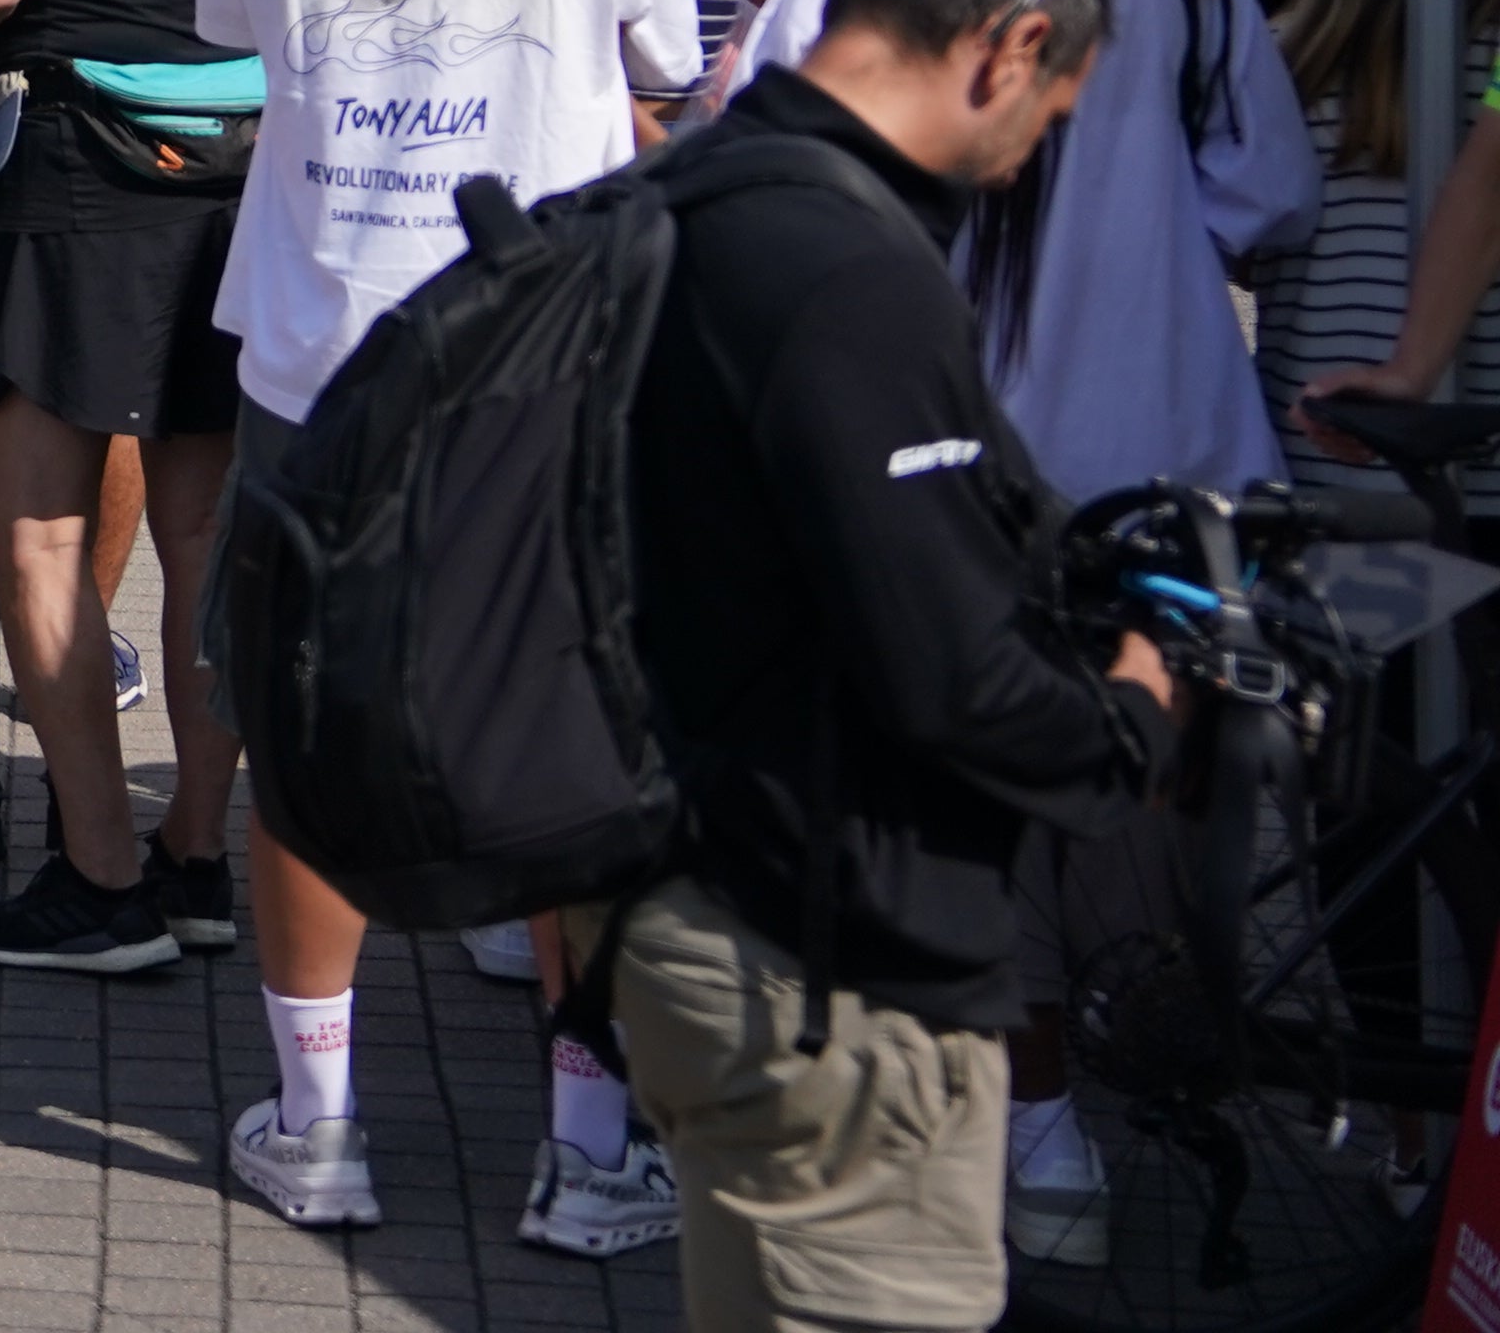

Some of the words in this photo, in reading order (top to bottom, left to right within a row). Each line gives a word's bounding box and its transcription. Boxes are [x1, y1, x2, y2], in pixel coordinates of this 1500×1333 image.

[407, 97, 488, 137] ALVA
[305, 159, 450, 193] REVOLUTIONARY
[295, 1028, 350, 1043] SERVI
